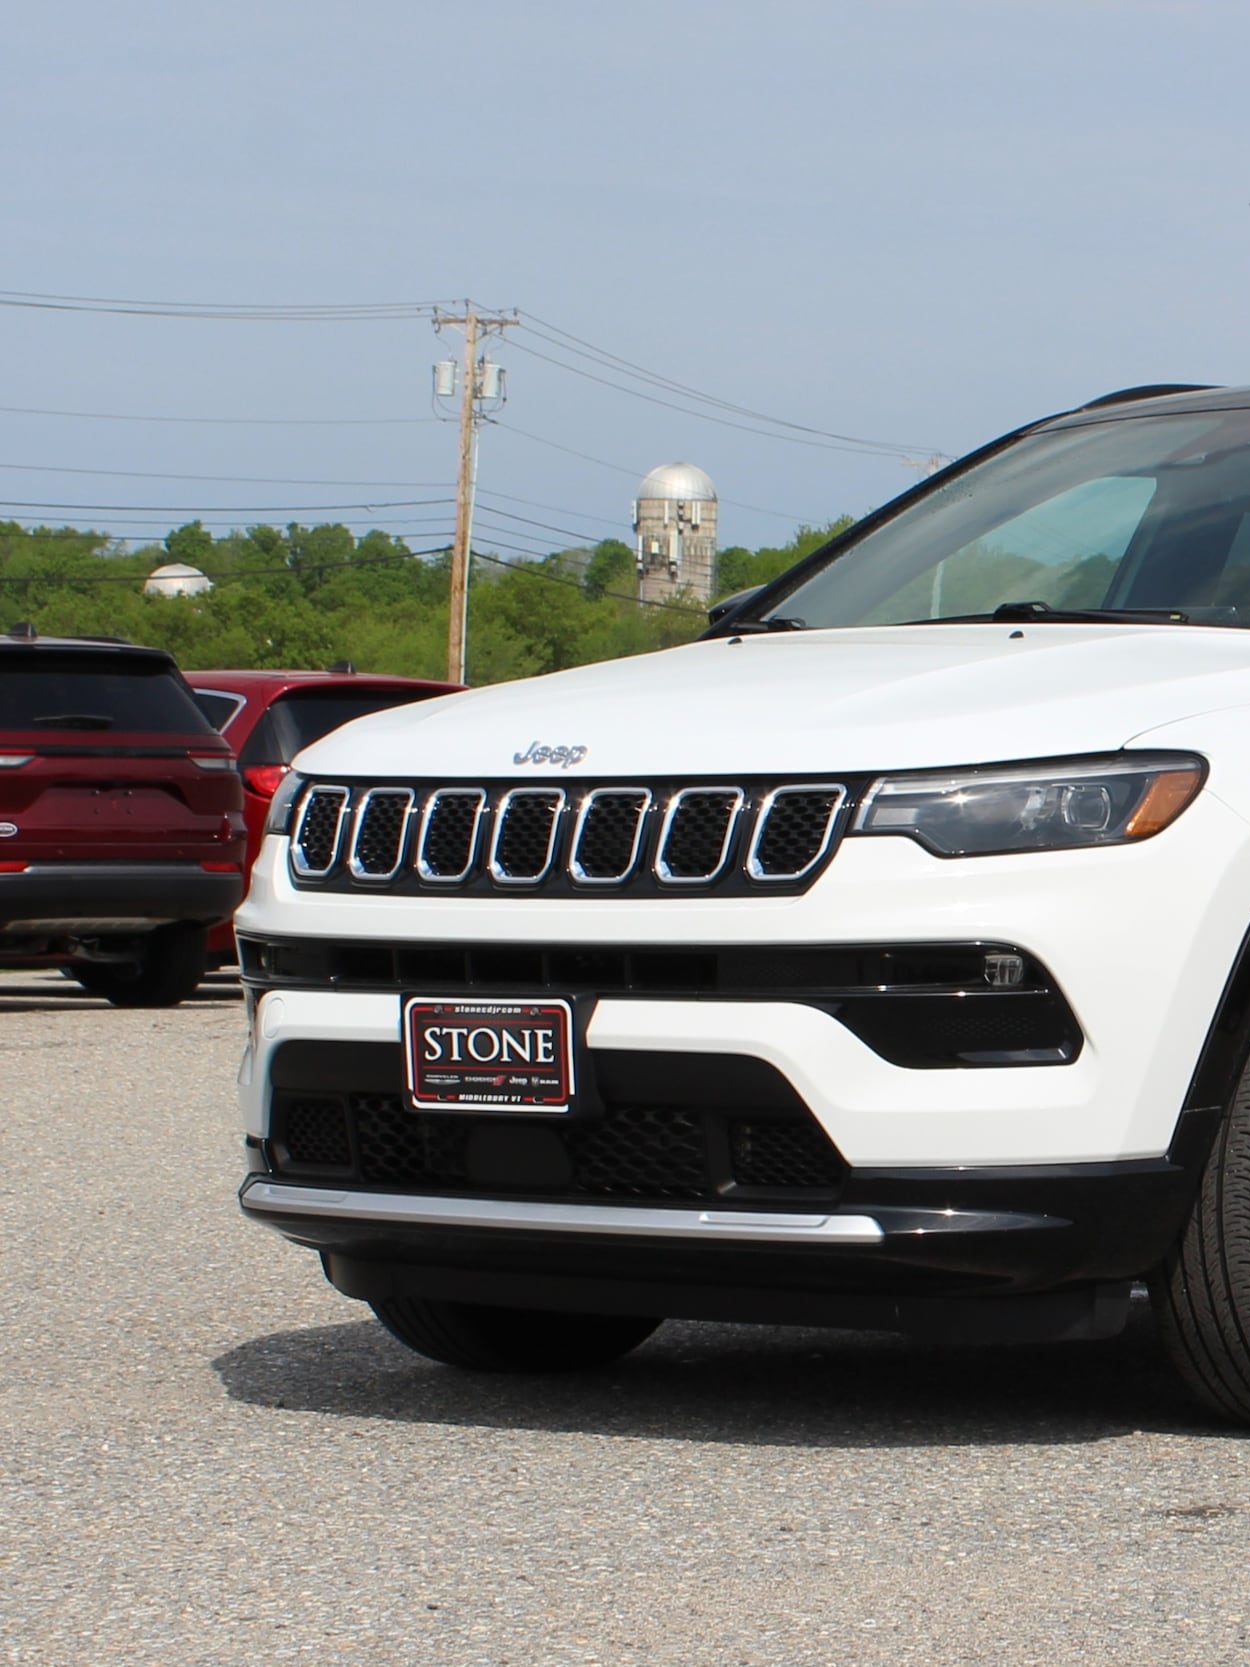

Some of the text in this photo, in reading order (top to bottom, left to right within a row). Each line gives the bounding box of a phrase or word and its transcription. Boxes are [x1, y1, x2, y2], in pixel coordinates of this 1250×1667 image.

[513, 740, 588, 769] Jeep
[424, 1027, 555, 1063] STONE
[508, 1075, 528, 1086] Jeep
[458, 1093, 521, 1103] MIDDLEBURY VT
